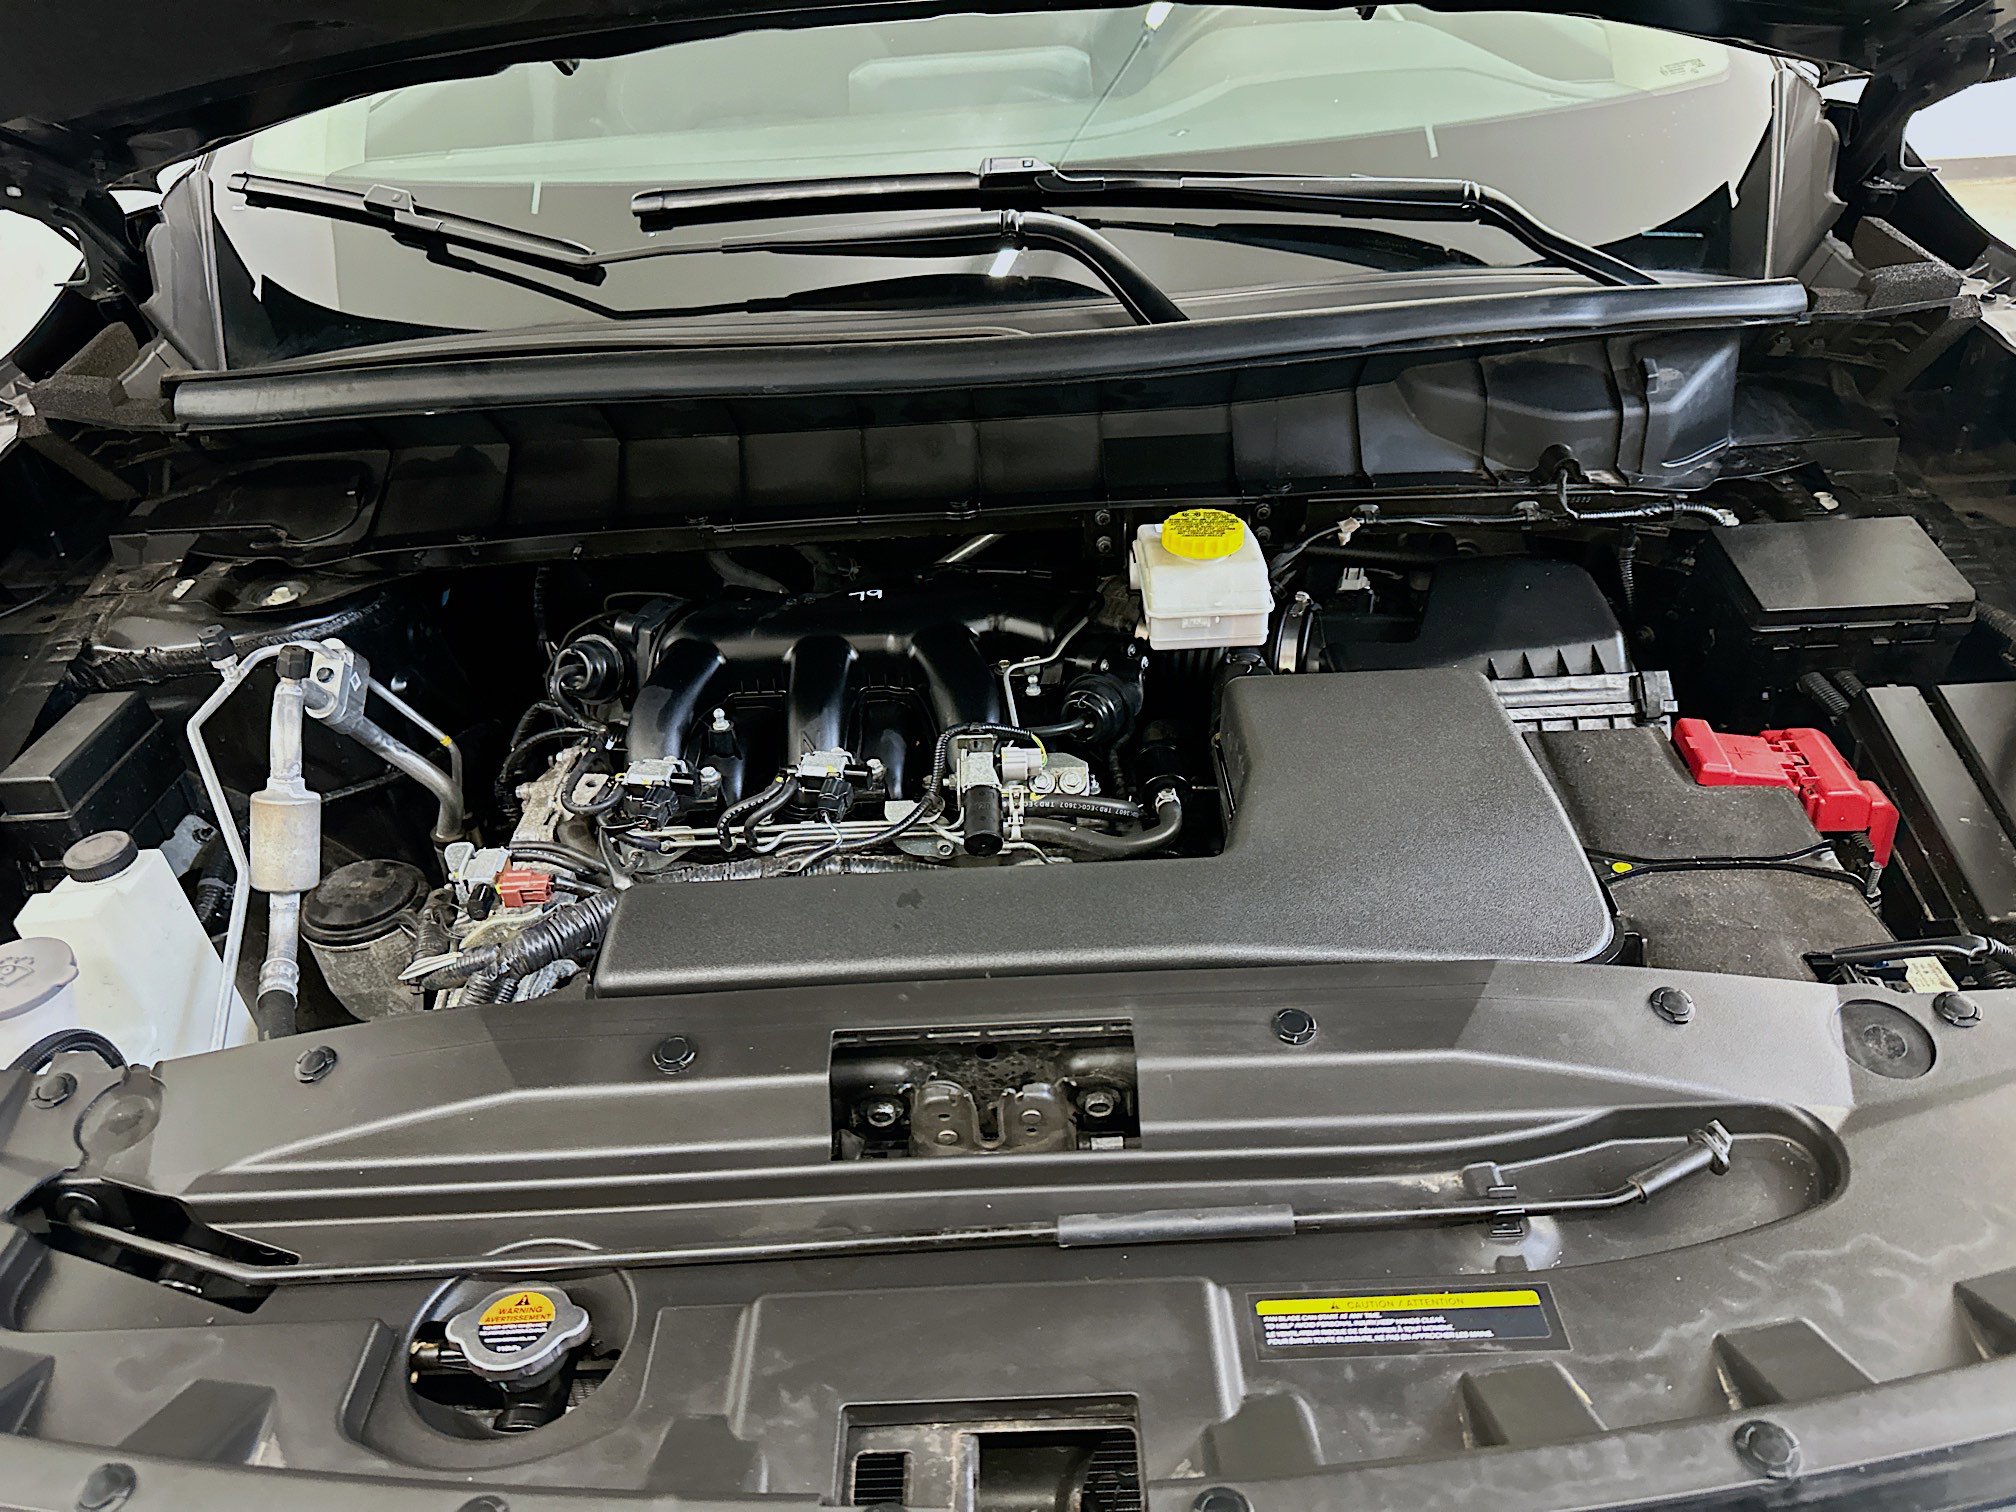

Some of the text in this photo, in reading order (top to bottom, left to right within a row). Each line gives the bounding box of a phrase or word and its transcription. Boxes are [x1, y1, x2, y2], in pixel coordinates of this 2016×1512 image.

[1347, 1300, 1394, 1310] CAUTION
[1406, 1298, 1464, 1307] ATTENTION
[499, 1306, 543, 1315] WARNING
[485, 1313, 551, 1323] AVERTISSEMENT
